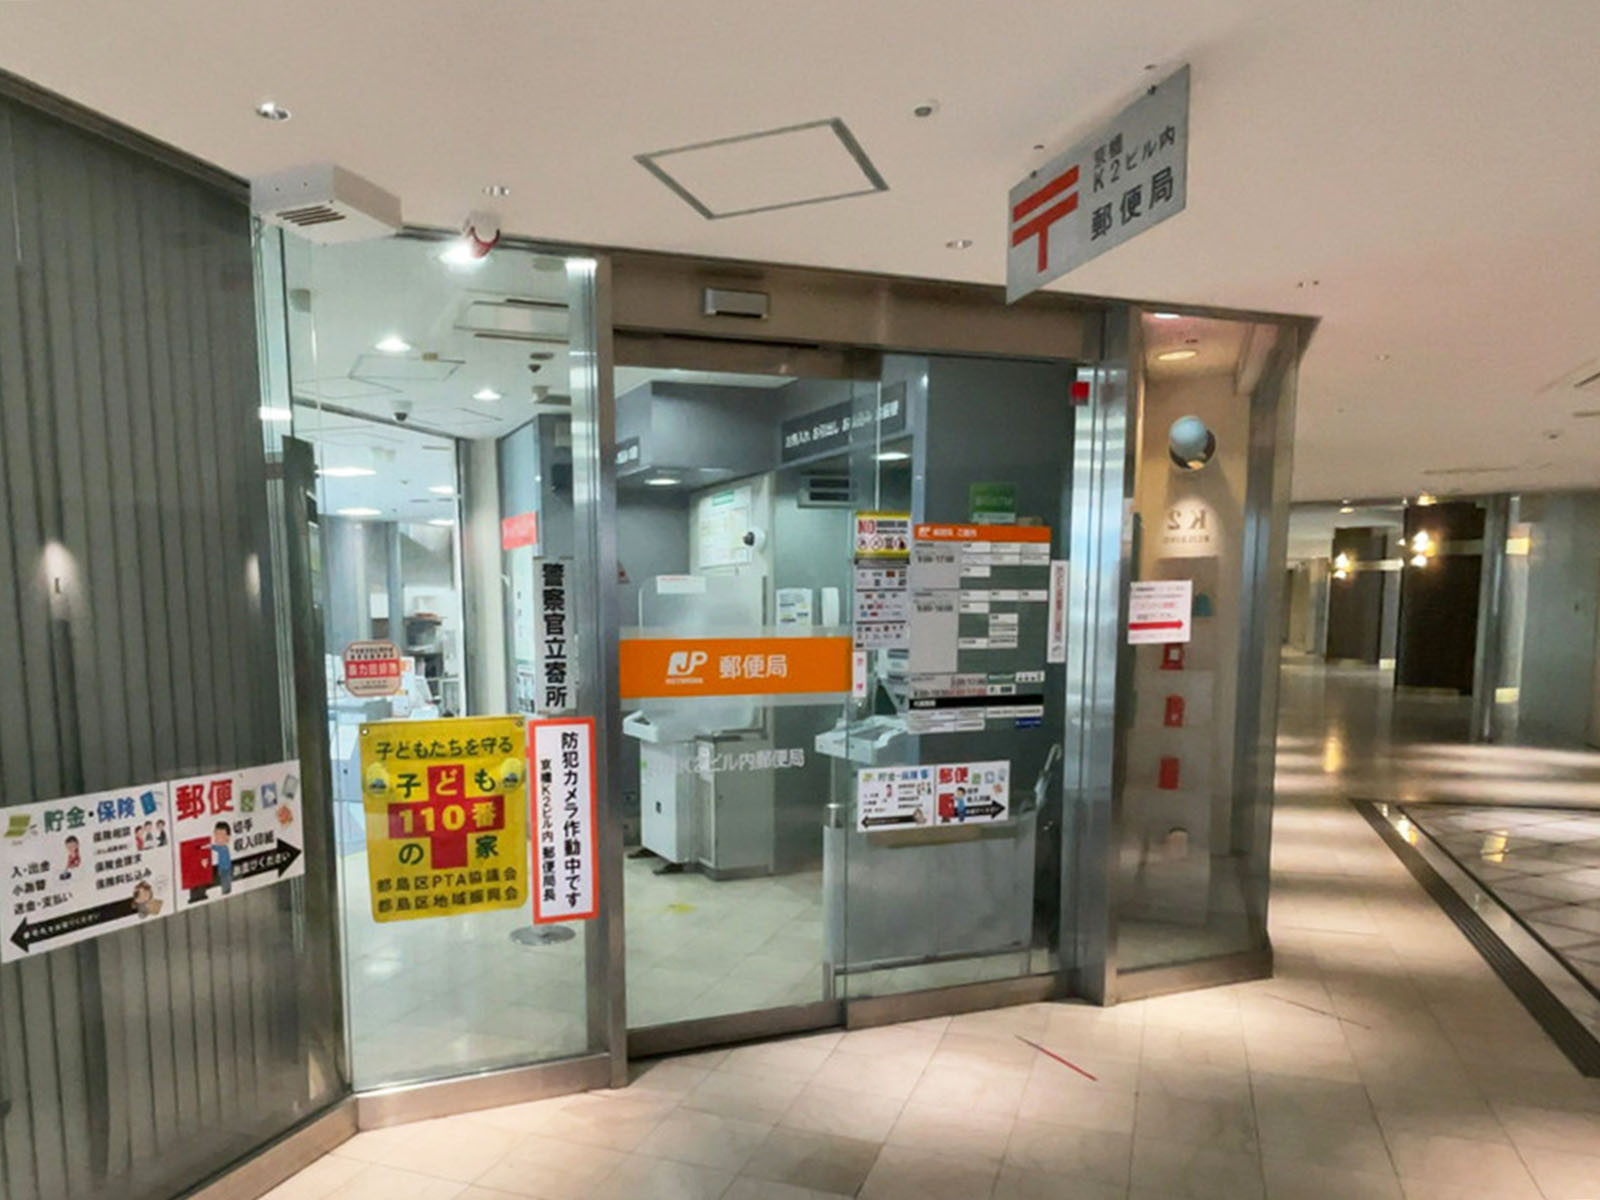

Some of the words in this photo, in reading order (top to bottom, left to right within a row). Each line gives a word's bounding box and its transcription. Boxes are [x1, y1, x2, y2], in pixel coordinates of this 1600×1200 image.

[1093, 125, 1175, 192] K2ビル内
[1091, 166, 1173, 241] 郵便局
[542, 563, 568, 708] 警察官立寄所
[720, 653, 787, 680] 郵便局
[376, 737, 514, 761] 子どもたちを守る
[176, 778, 235, 822] 郵便
[396, 767, 496, 798] 子ども
[400, 802, 497, 833] 110番
[561, 731, 582, 908] 防犯カメラ作動中です
[398, 836, 499, 865] の家
